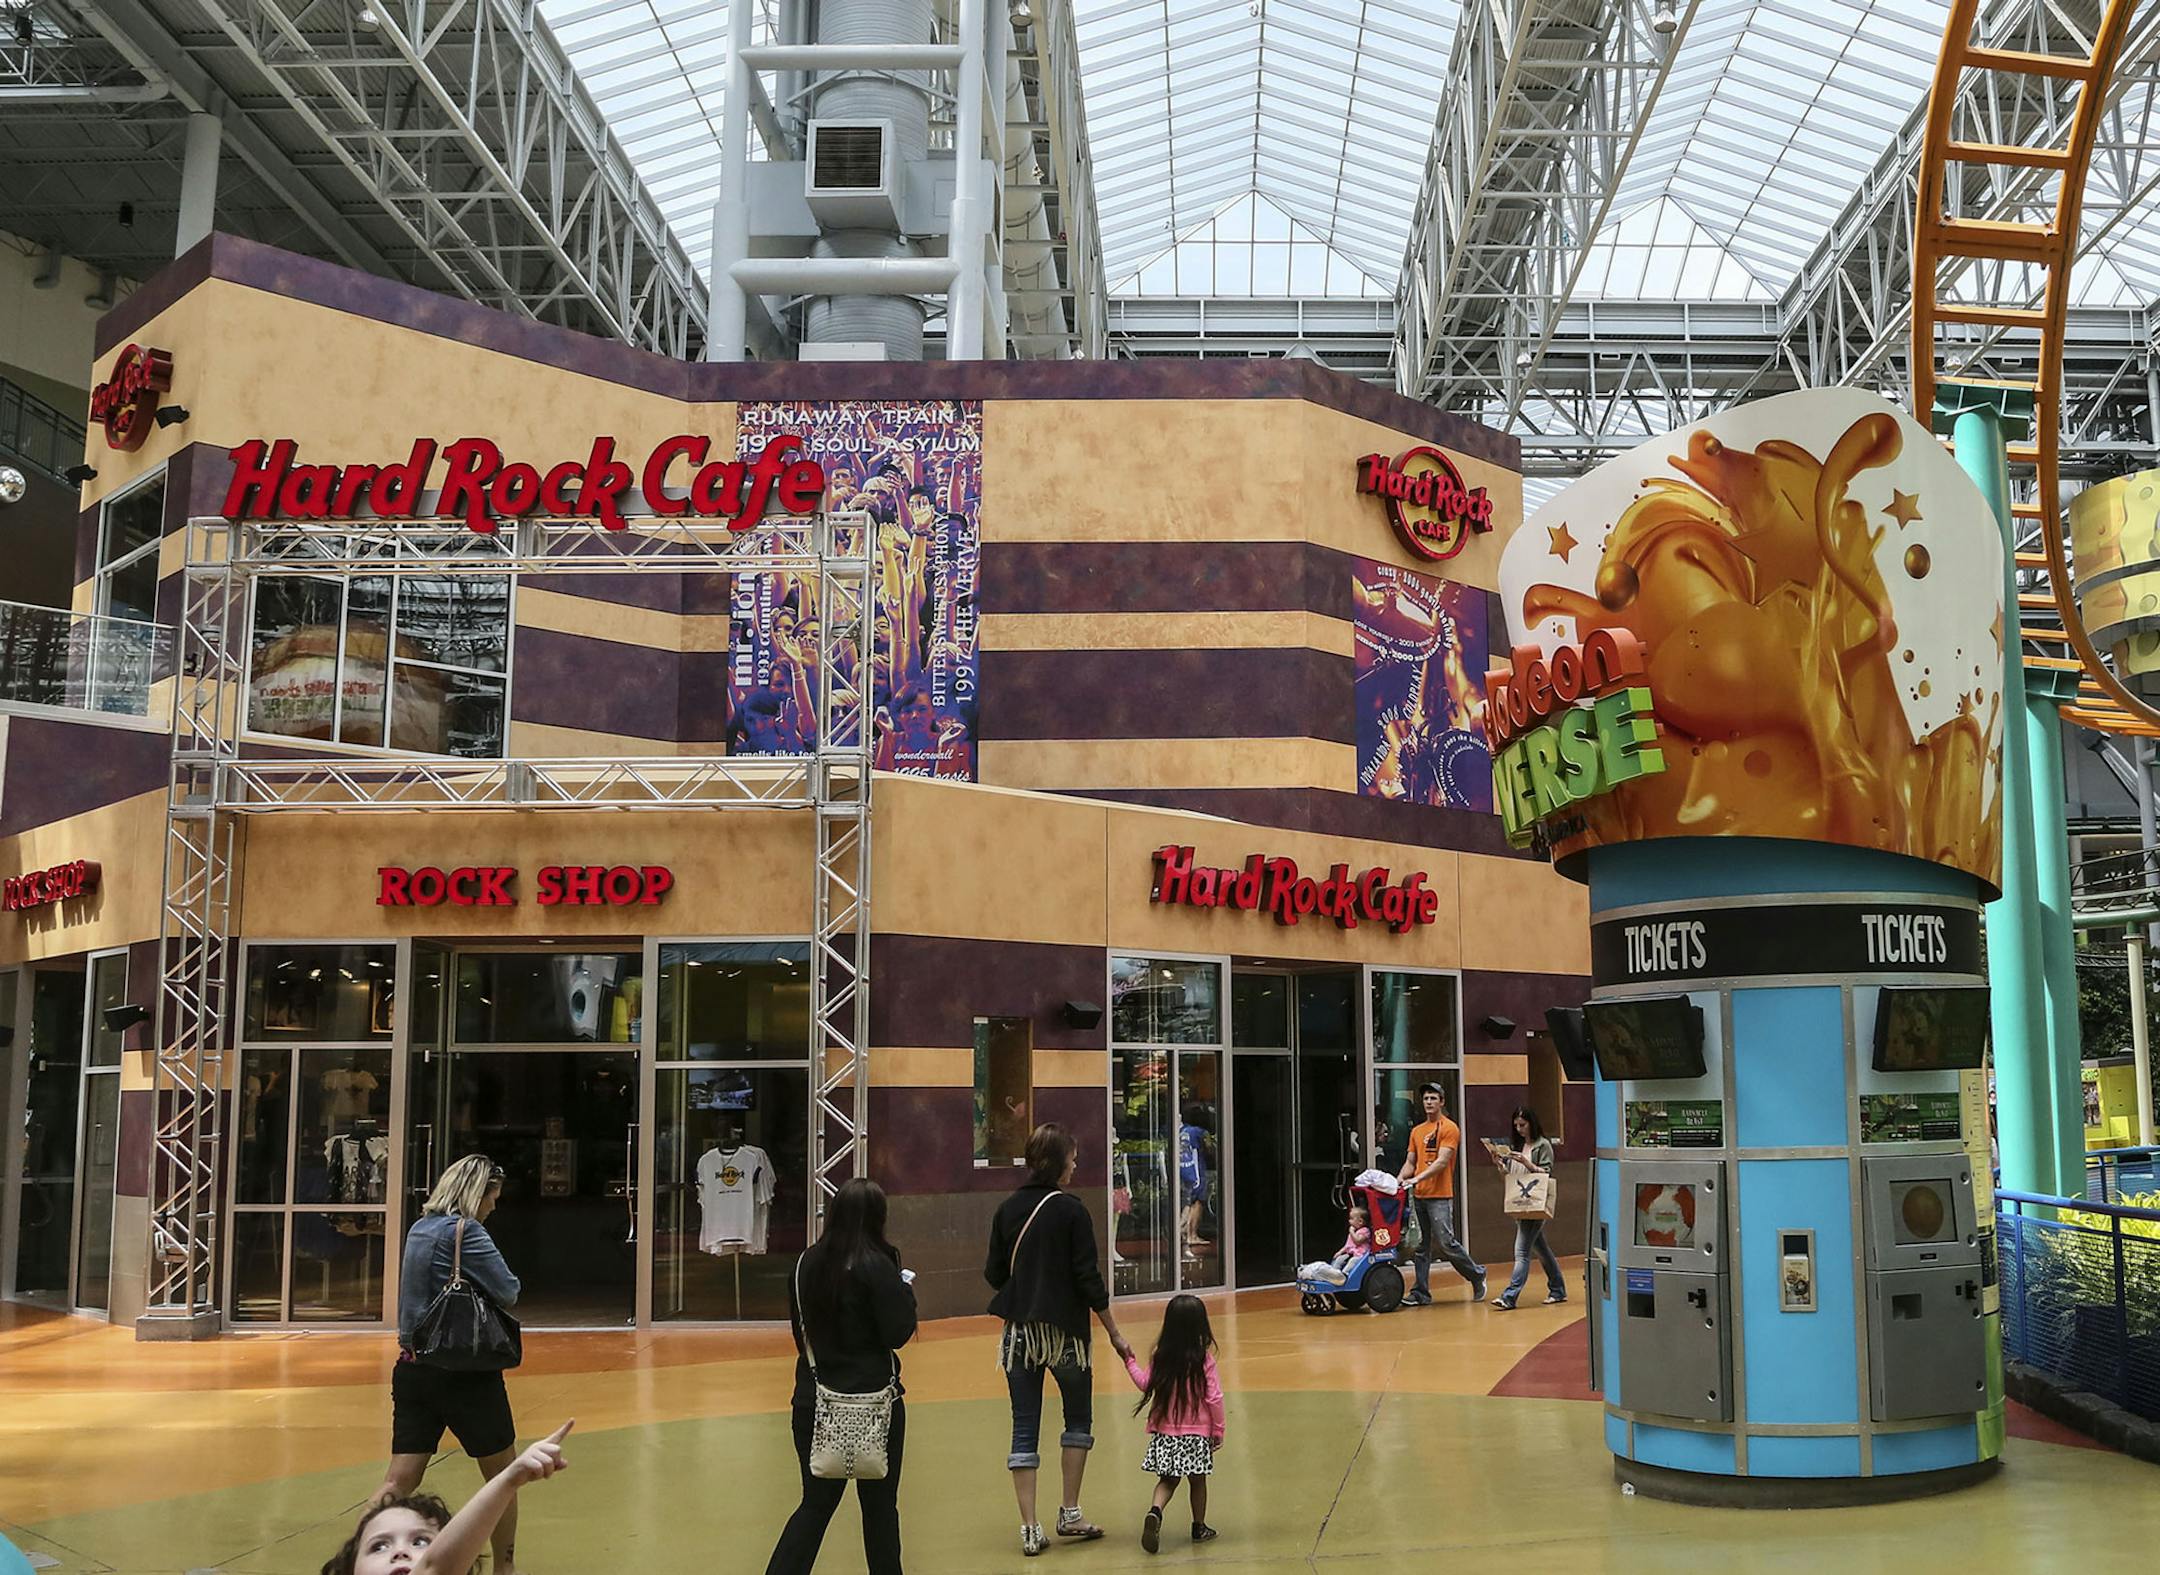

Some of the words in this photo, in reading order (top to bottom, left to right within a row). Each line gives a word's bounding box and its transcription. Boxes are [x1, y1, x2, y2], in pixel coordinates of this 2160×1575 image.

[743, 410, 873, 426] RUNAWAY
[882, 410, 954, 425] TRAIN
[811, 437, 874, 454] SOUL
[882, 436, 980, 453] ASYLUM
[221, 438, 437, 521] Hard
[436, 437, 633, 532] Rock
[642, 434, 826, 534] Cafe
[1357, 453, 1433, 507] Hard
[1430, 474, 1494, 534] Rock
[1413, 519, 1451, 542] CAFE
[955, 528, 975, 599] VERVE
[758, 573, 773, 647] counting
[956, 605, 974, 645] THE
[732, 629, 755, 687] mr.
[758, 649, 773, 686] 1993
[955, 652, 976, 704] 1997
[1391, 649, 1414, 662] 2000
[1402, 664, 1423, 720] COLDPLAY
[1484, 627, 1645, 748] lodeon
[894, 749, 954, 761] wonderwall
[1493, 686, 1667, 842] VERSE
[2, 870, 44, 912] ROCK
[45, 860, 94, 903] SHOP
[377, 867, 518, 908] ROCK
[537, 864, 673, 908] SHOP
[1150, 844, 1266, 910] Hard
[1259, 856, 1358, 929] Rock
[1356, 866, 1439, 934] Cafe
[1624, 920, 1708, 974] TICKETS
[1861, 913, 1948, 965] TICKETS
